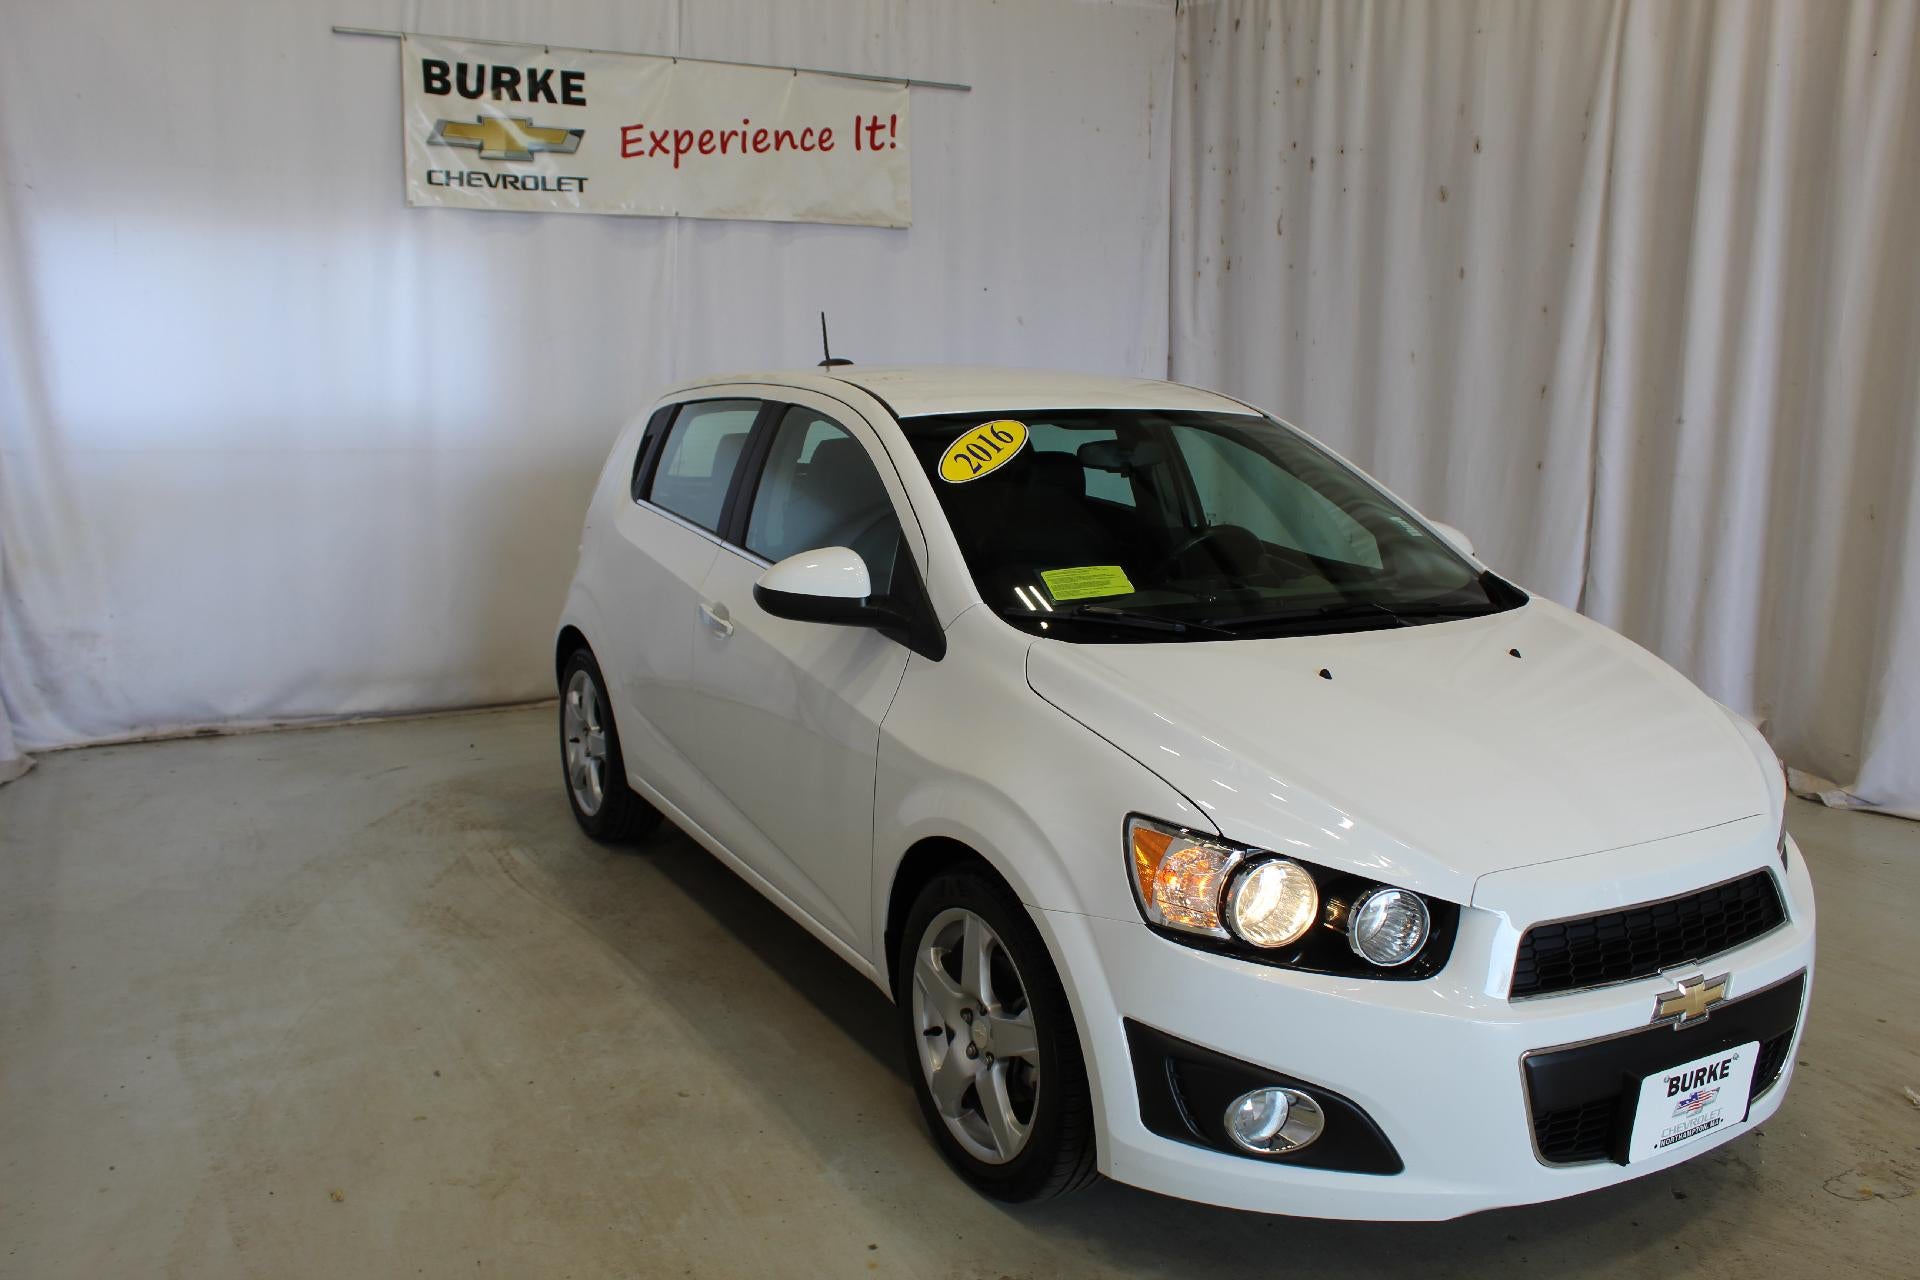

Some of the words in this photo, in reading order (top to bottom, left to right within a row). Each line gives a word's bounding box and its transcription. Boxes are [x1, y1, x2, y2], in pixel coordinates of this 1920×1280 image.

[422, 58, 587, 106] BURKE
[620, 118, 834, 168] Experience
[854, 114, 898, 151] It!
[426, 168, 588, 193] CHEVROLET
[953, 424, 1014, 474] 2016
[1667, 1058, 1732, 1098] BURKE
[1661, 1107, 1721, 1138] CHEVROLET
